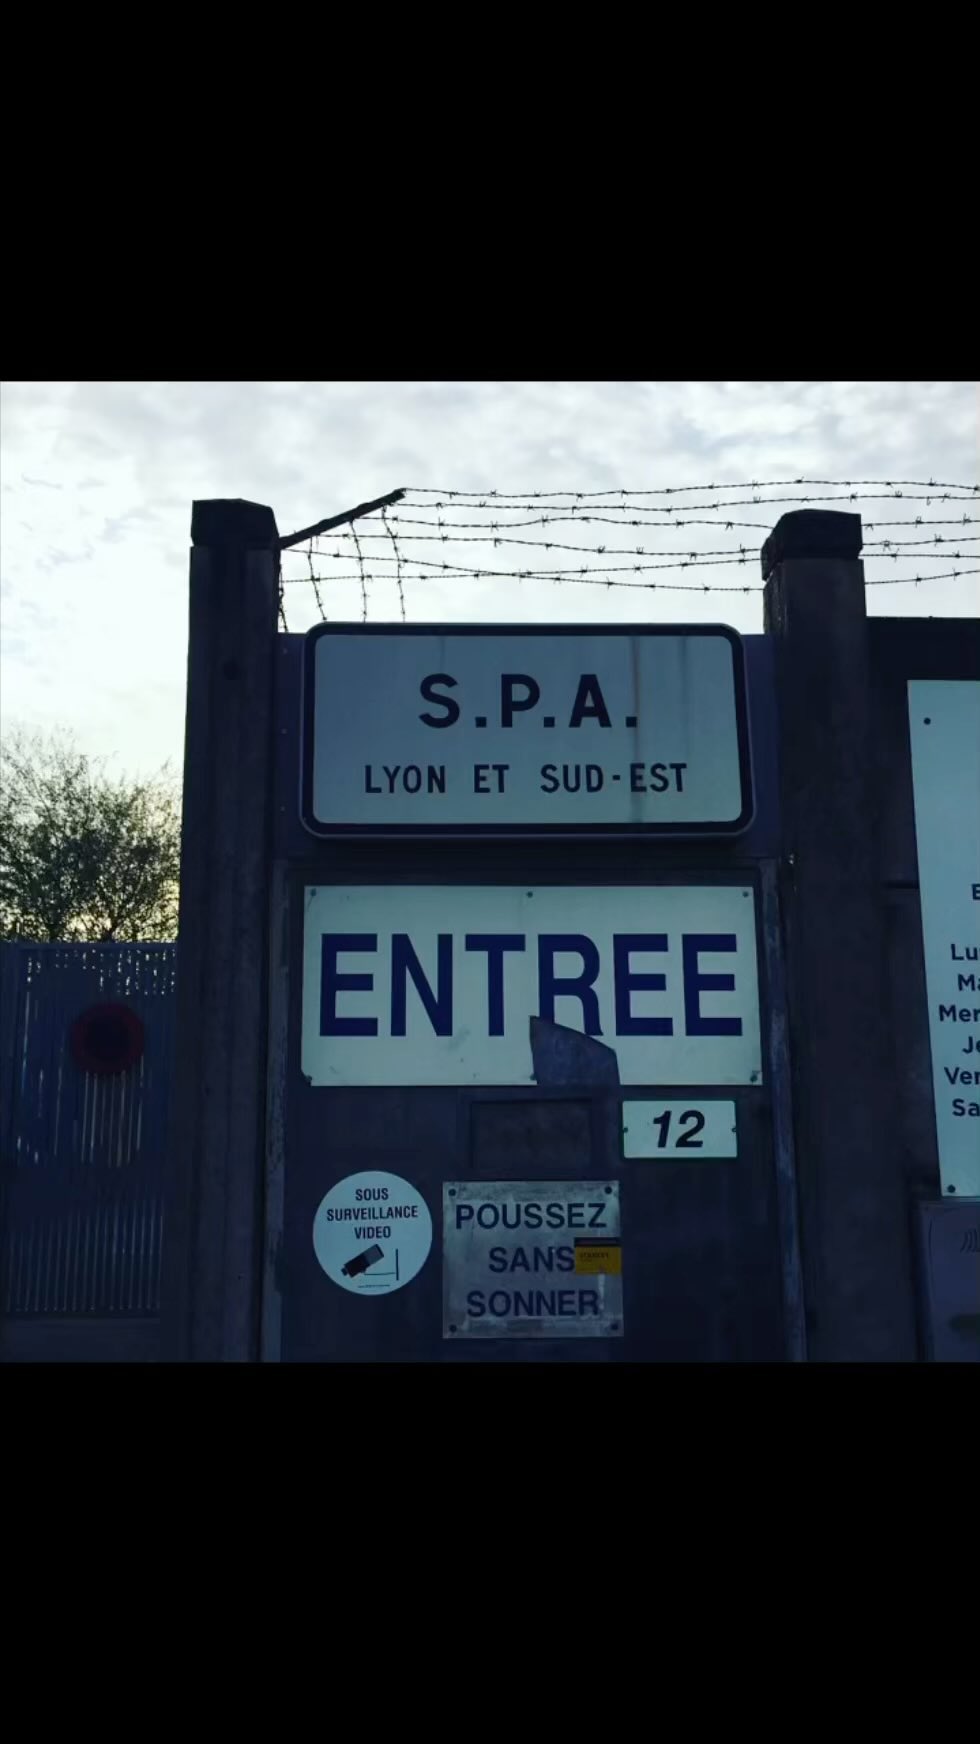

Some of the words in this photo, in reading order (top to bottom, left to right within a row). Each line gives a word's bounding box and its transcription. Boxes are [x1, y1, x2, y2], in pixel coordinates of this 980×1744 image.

[418, 673, 638, 728] S.P.A.
[365, 764, 446, 794] LYON
[474, 764, 510, 793] ET
[540, 762, 688, 793] SUD-EST
[950, 943, 980, 961] Lu
[319, 933, 744, 1037] ENTREE
[957, 973, 980, 992] M
[651, 1109, 706, 1149] 12
[355, 1187, 389, 1201] SOUS
[326, 1205, 419, 1222] SURVEILLANCE
[455, 1202, 607, 1230] POUSSEZ
[354, 1225, 391, 1240] VIDEO
[488, 1246, 575, 1273] SANS
[466, 1290, 600, 1318] SONNER
